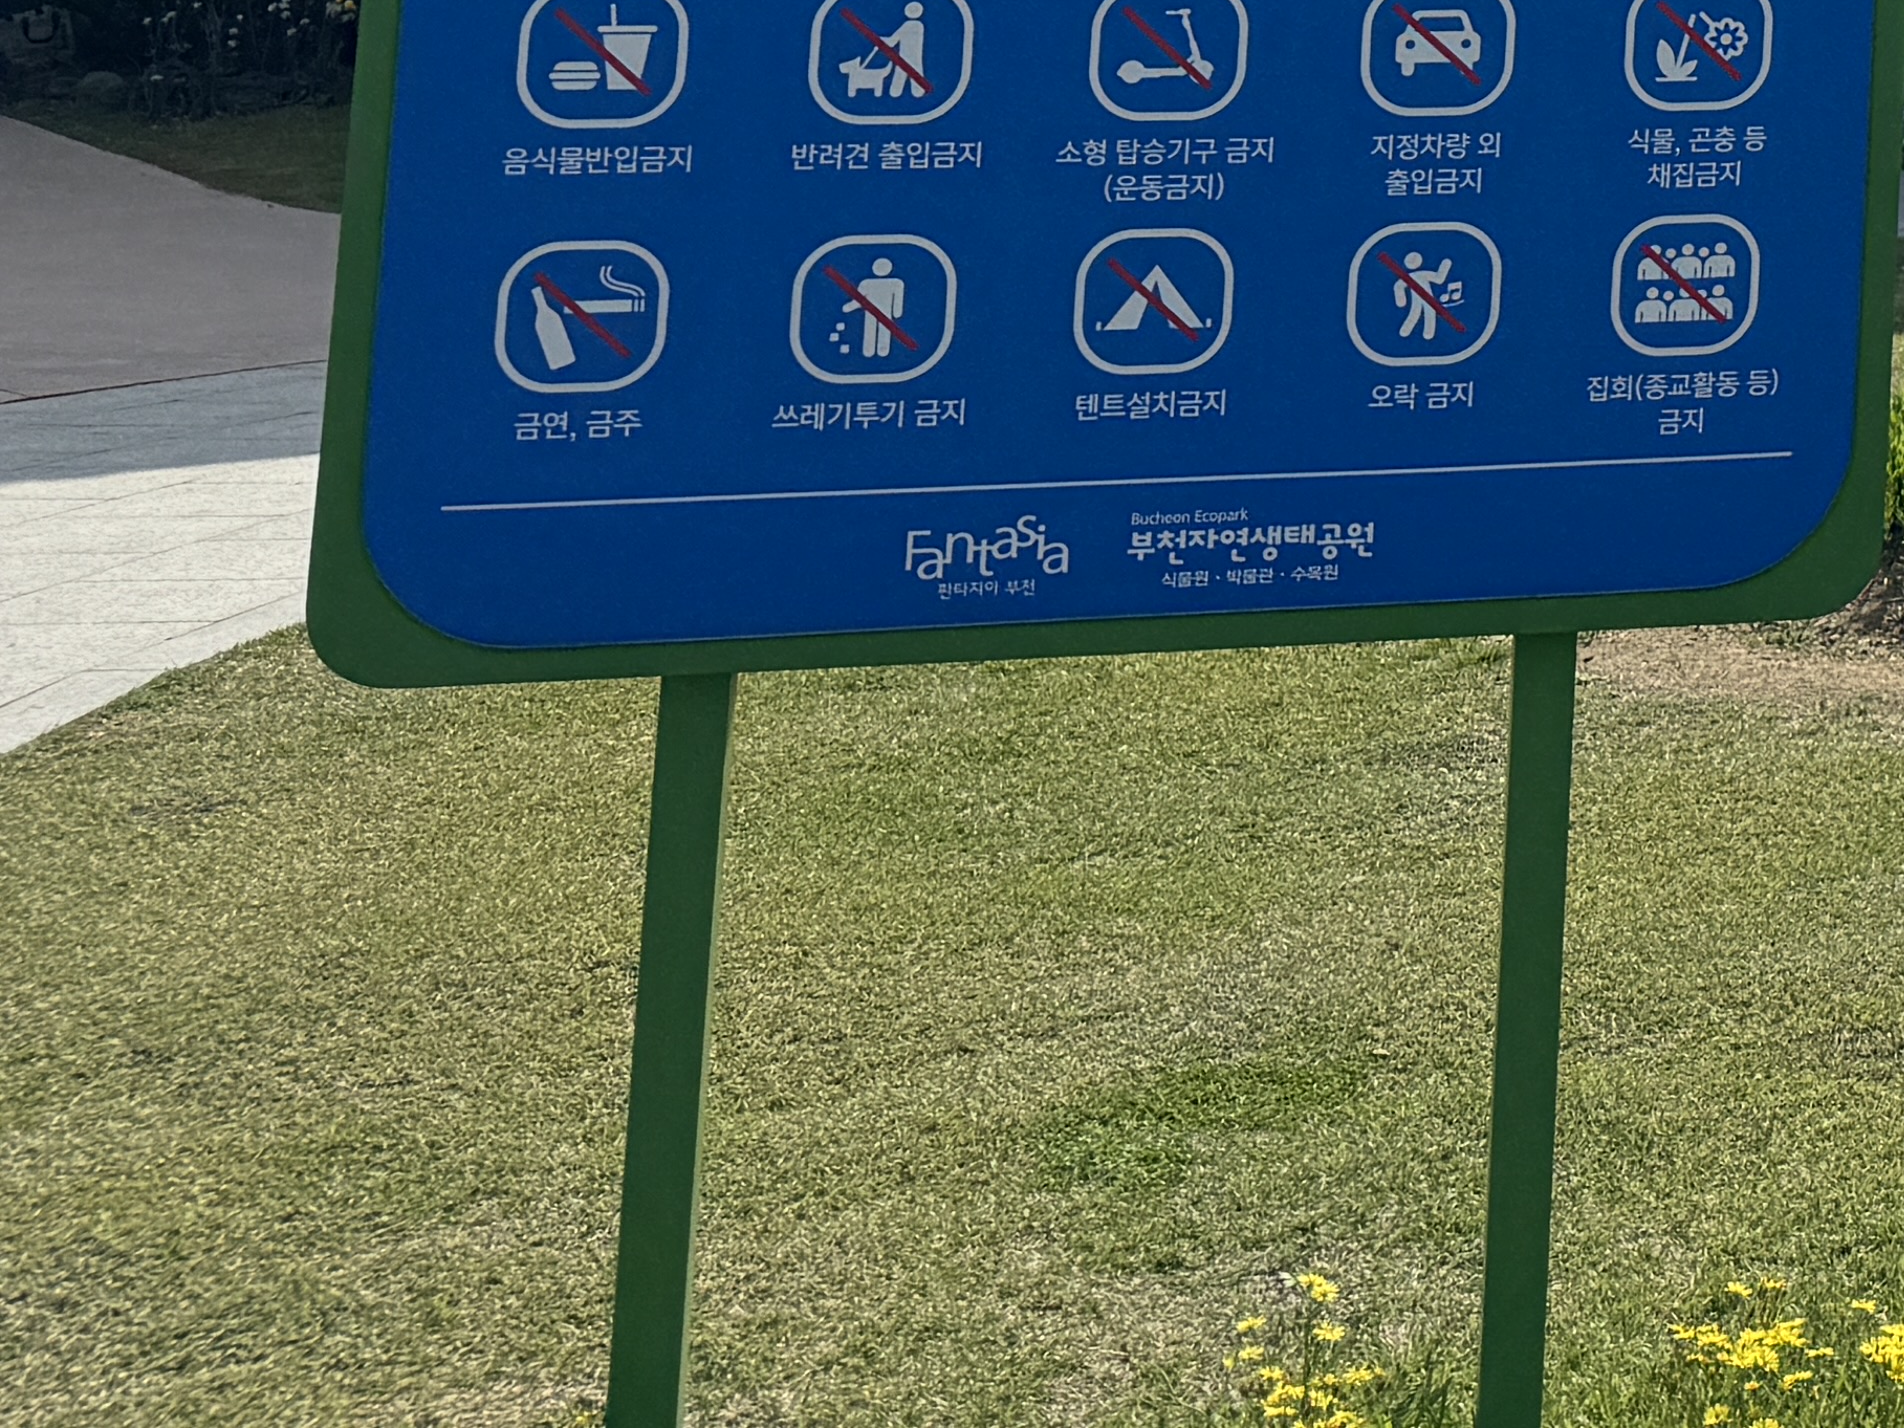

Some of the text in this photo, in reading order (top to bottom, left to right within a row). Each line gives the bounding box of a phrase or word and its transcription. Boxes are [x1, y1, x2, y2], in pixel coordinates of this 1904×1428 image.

[792, 141, 981, 170] 반려견 출입금지
[1056, 137, 1274, 166] 소형 탑승기구 금지
[1371, 132, 1500, 160] 지정차량 외
[1628, 126, 1767, 156] 식물, 곤충 등
[503, 145, 692, 175] 음식물반입금지
[1648, 161, 1741, 188] 채집금지
[1104, 173, 1224, 202] (운동금지)
[1385, 168, 1482, 196] 출입금지
[1368, 381, 1473, 410] 오락 금지
[1587, 368, 1778, 401] 집회(종교활동 등)
[772, 398, 965, 431] 쓰레기투기 금지
[1076, 389, 1226, 421] 텐트설치금지
[514, 410, 642, 441] 금연, 금주
[1659, 408, 1703, 435] 금지
[1131, 508, 1248, 525] Bucheon Ecopark
[1127, 520, 1374, 566] 부천자연생태공원
[1162, 564, 1338, 587] 식물원 박물관 수목원
